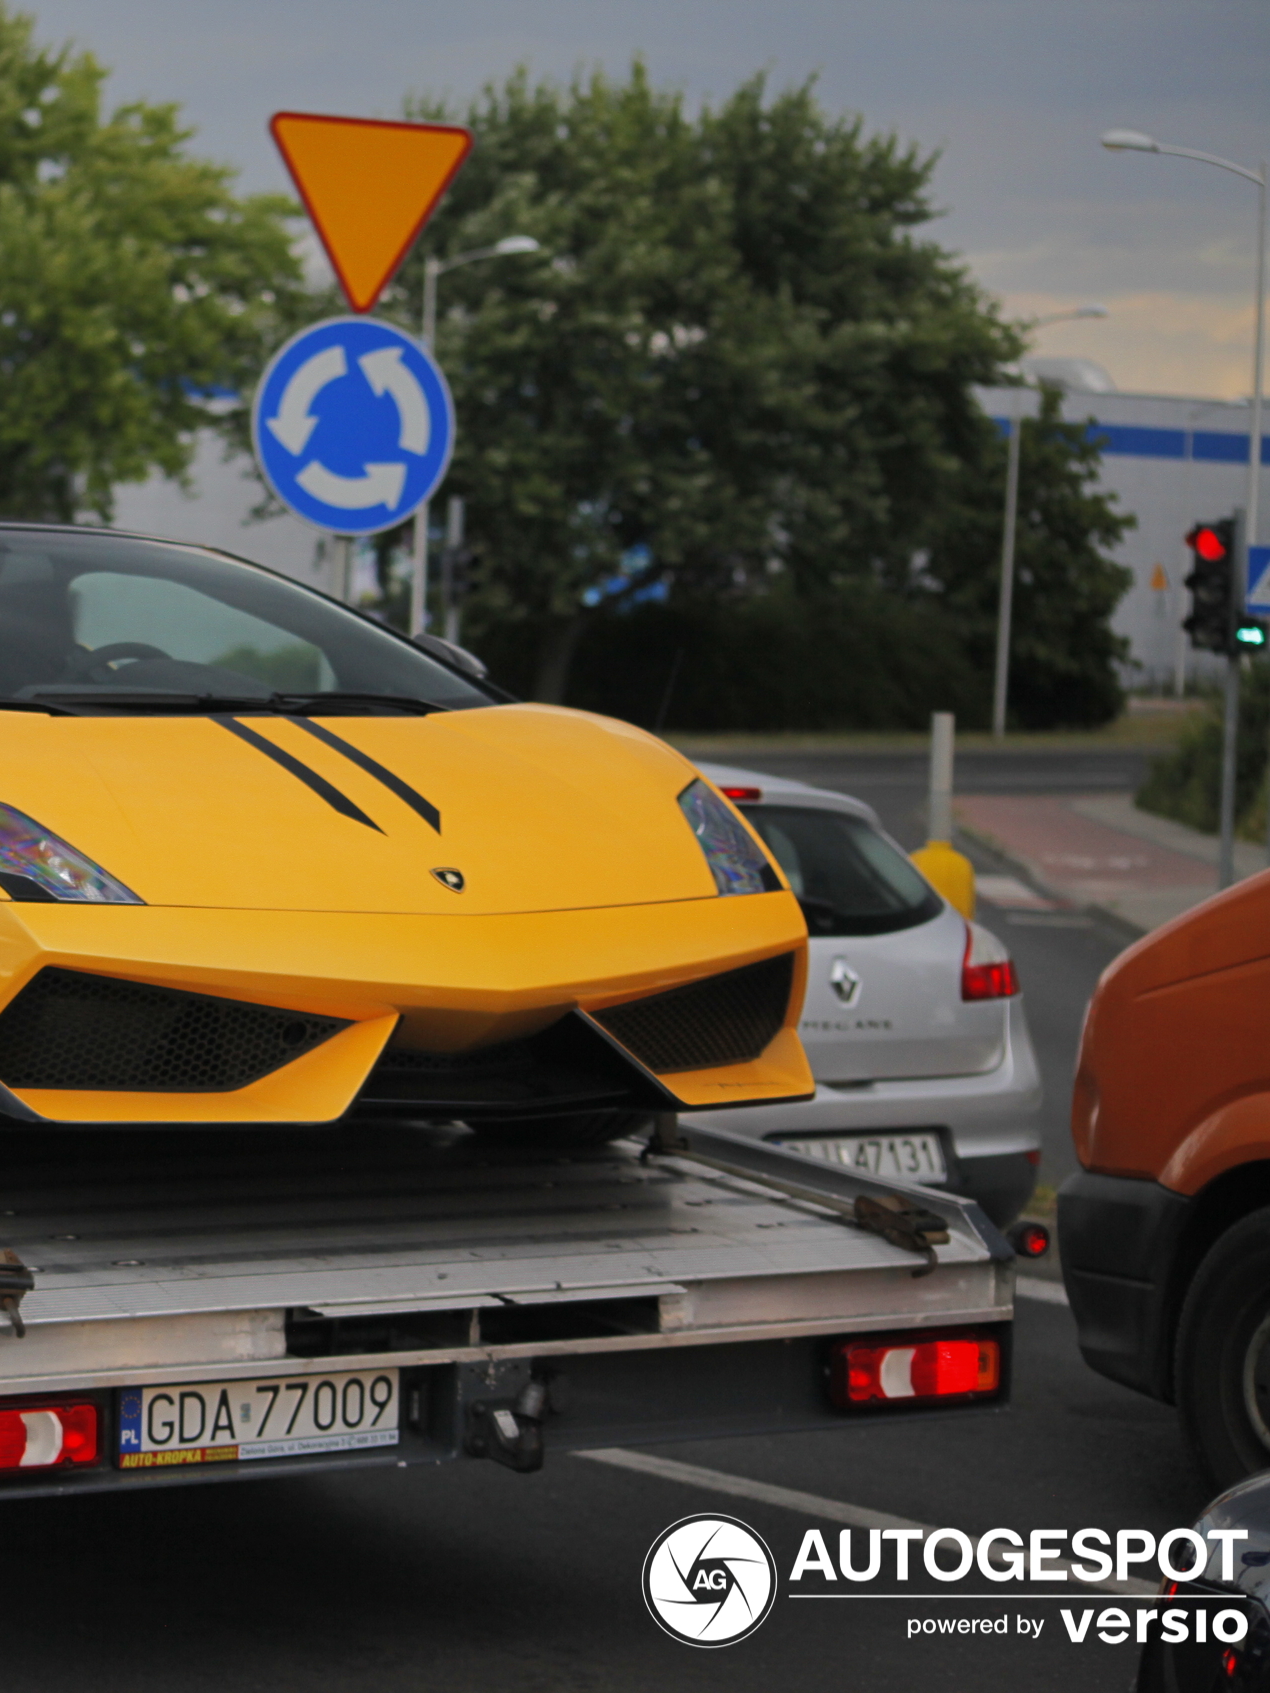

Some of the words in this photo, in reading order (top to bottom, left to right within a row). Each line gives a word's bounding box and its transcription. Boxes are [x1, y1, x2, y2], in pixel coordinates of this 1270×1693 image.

[147, 1388, 236, 1446] GDA
[256, 1375, 393, 1439] 77009
[121, 1429, 139, 1445] PL
[122, 1448, 203, 1468] AUTO-KROPKA
